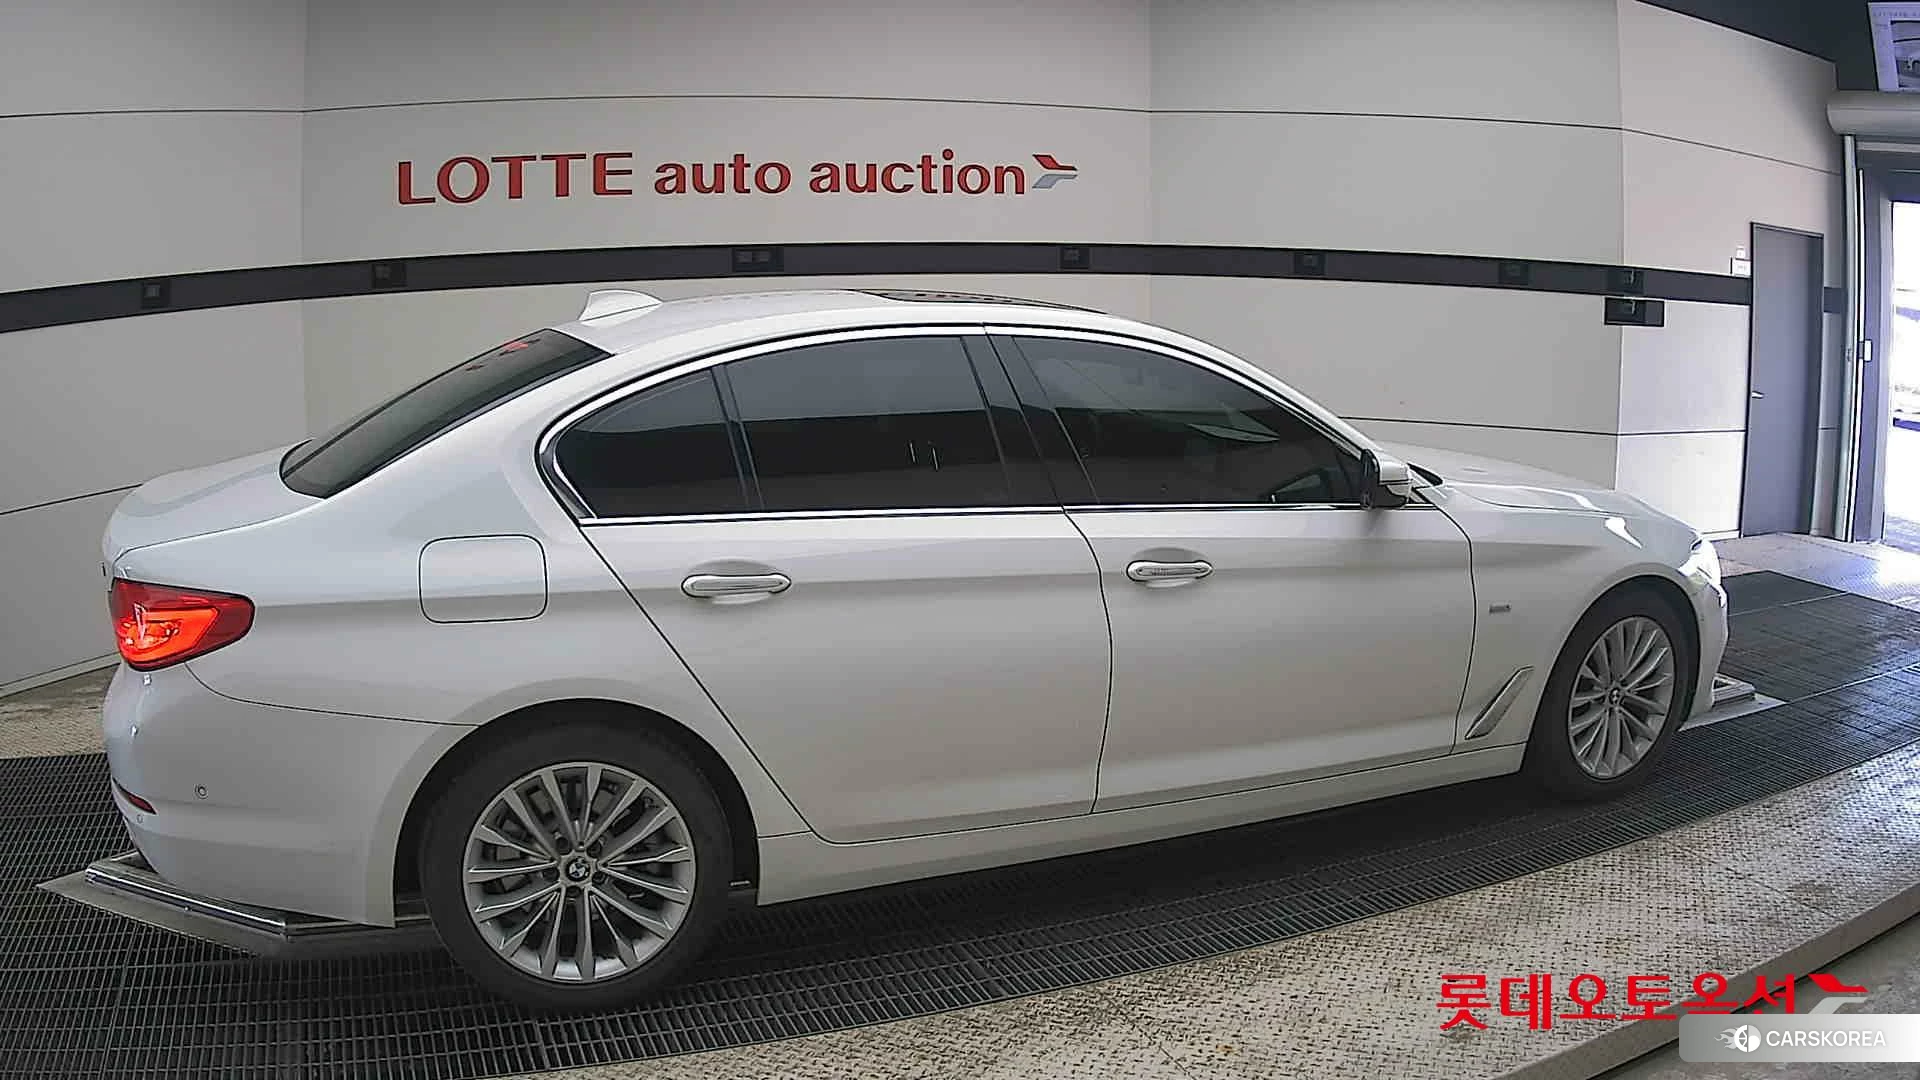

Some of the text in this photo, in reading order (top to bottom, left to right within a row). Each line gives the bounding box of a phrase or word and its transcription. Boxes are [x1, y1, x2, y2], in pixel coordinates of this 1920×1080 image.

[398, 149, 1026, 205] LOTTE auto auction
